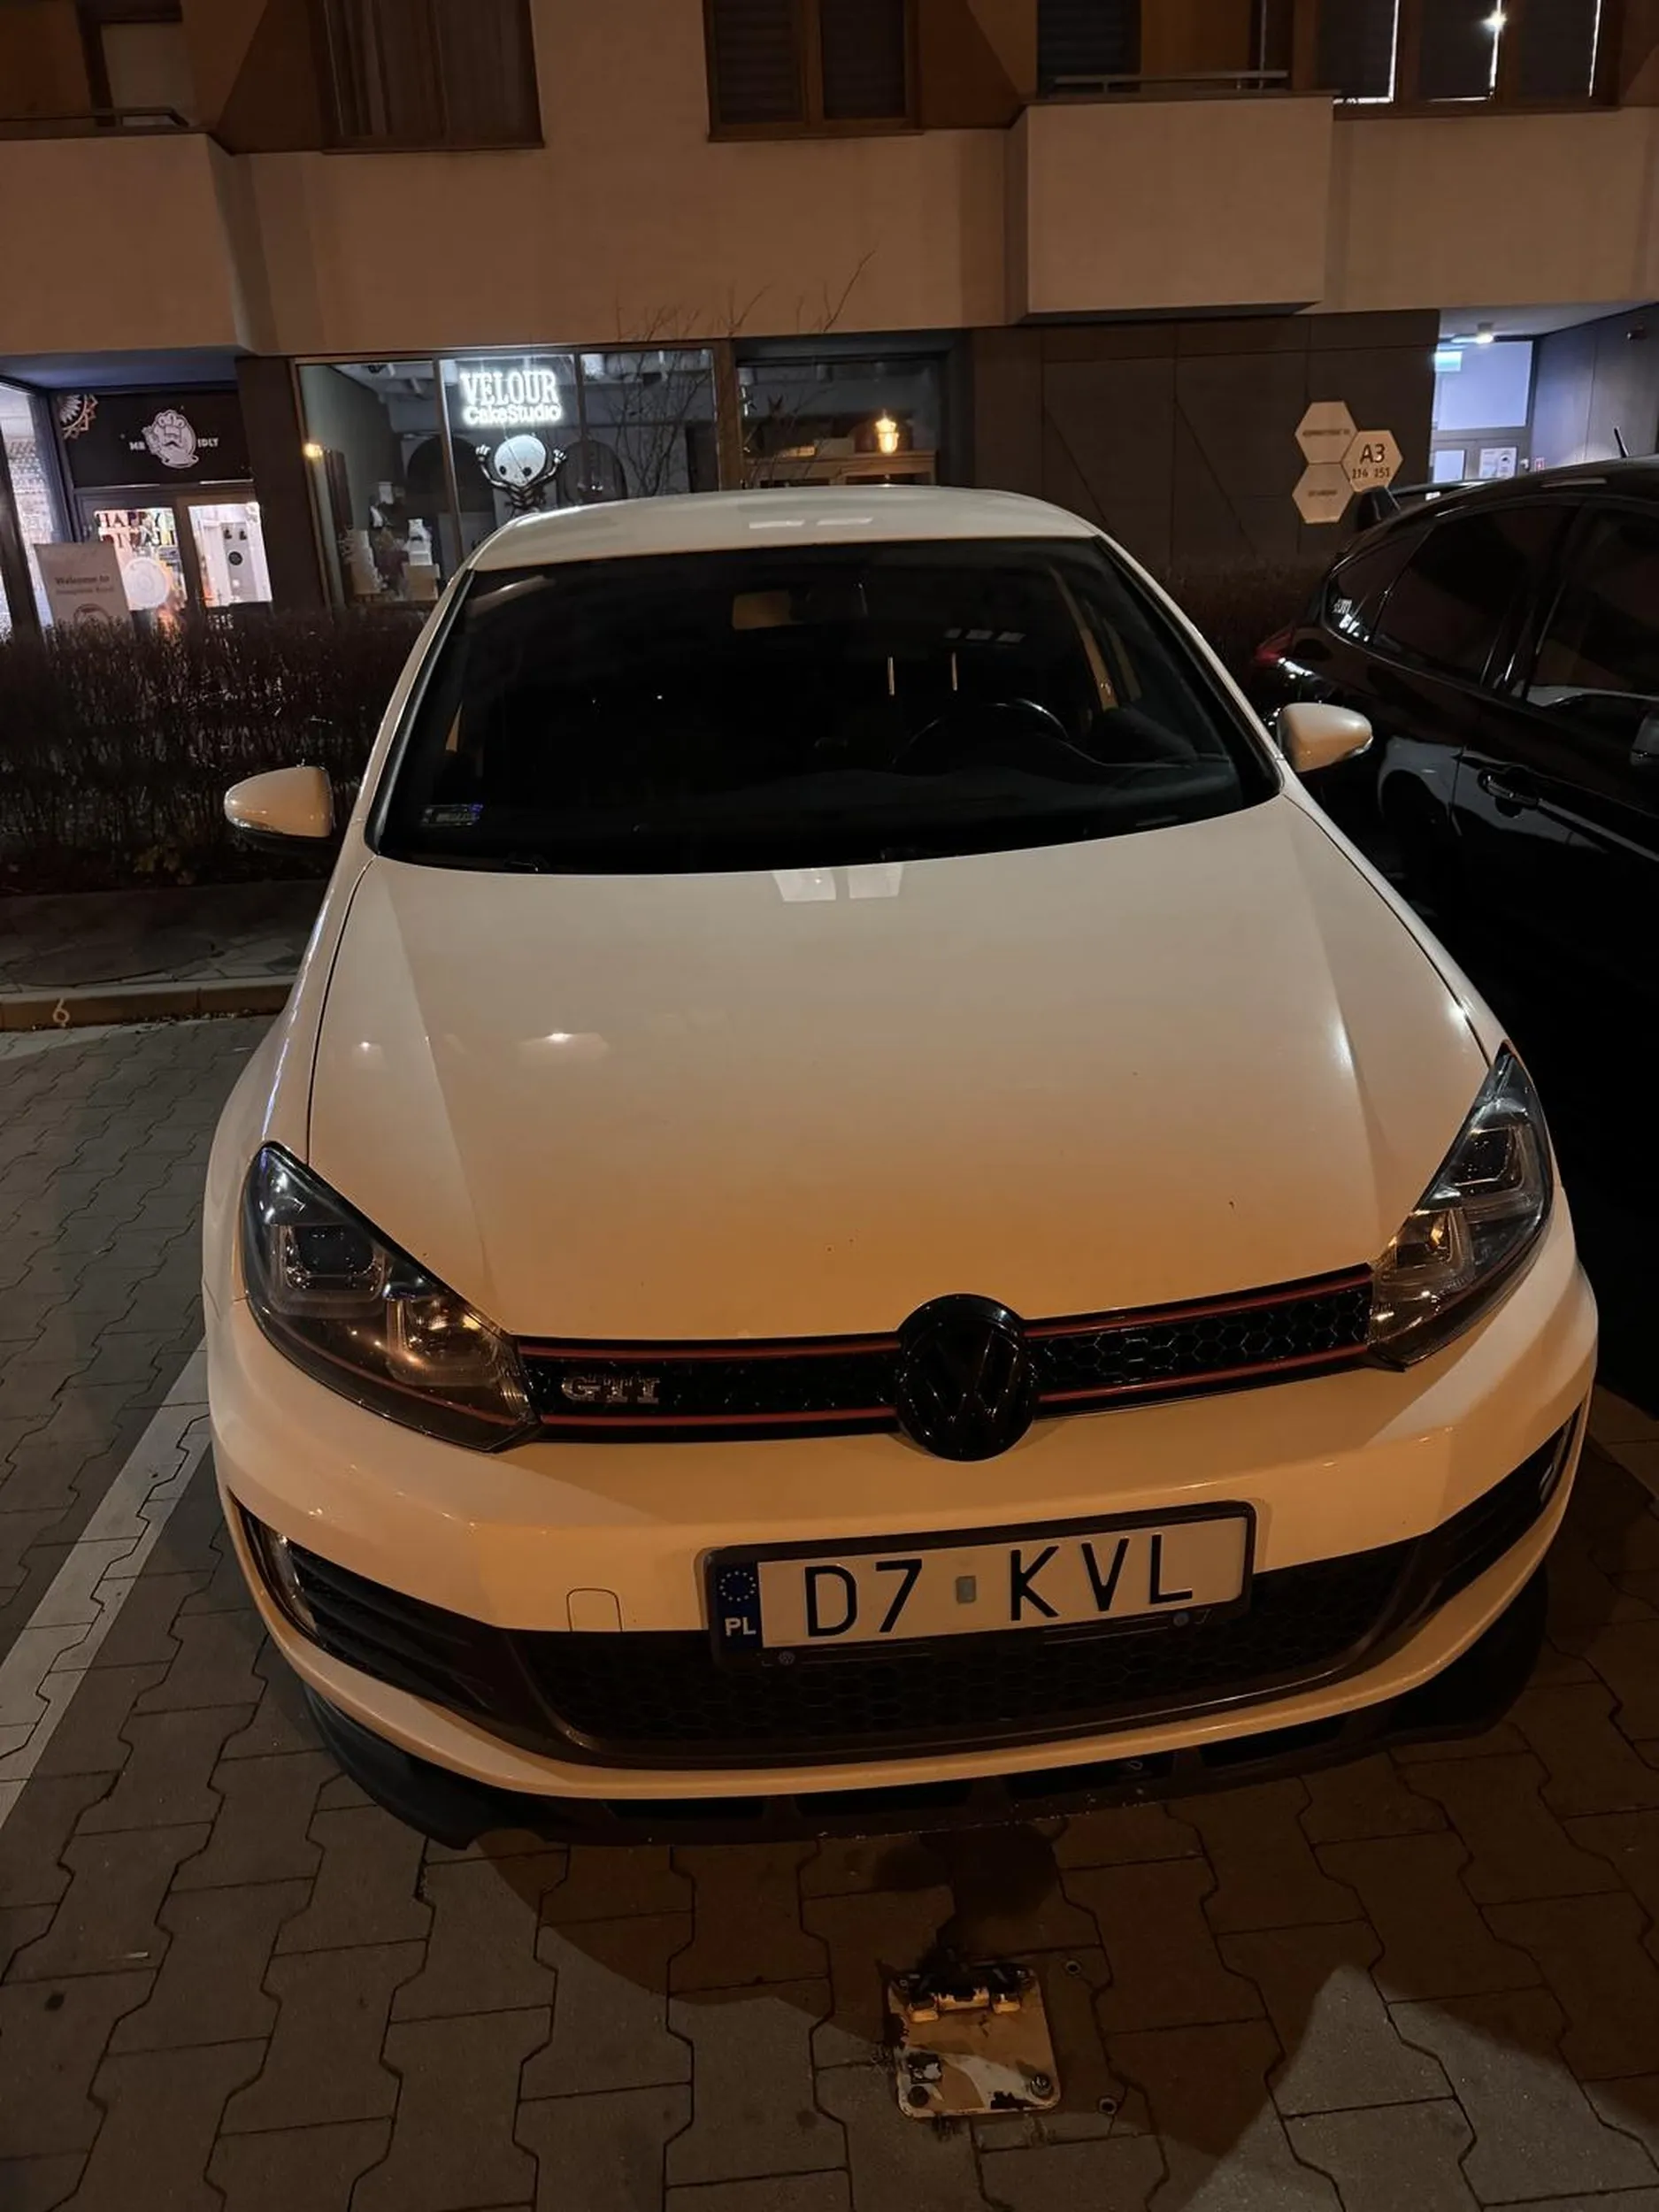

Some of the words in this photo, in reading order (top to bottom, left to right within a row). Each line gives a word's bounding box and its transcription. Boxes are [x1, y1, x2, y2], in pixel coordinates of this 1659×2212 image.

[460, 369, 559, 405] VELOUR
[1359, 443, 1386, 465] A3
[1374, 467, 1391, 479] 151
[95, 511, 160, 527] HAPPY
[52, 998, 70, 1025] 6
[561, 1375, 661, 1405] GTI
[803, 1558, 923, 1637] D7
[1009, 1534, 1194, 1621] KVL
[725, 1617, 757, 1637] PL
